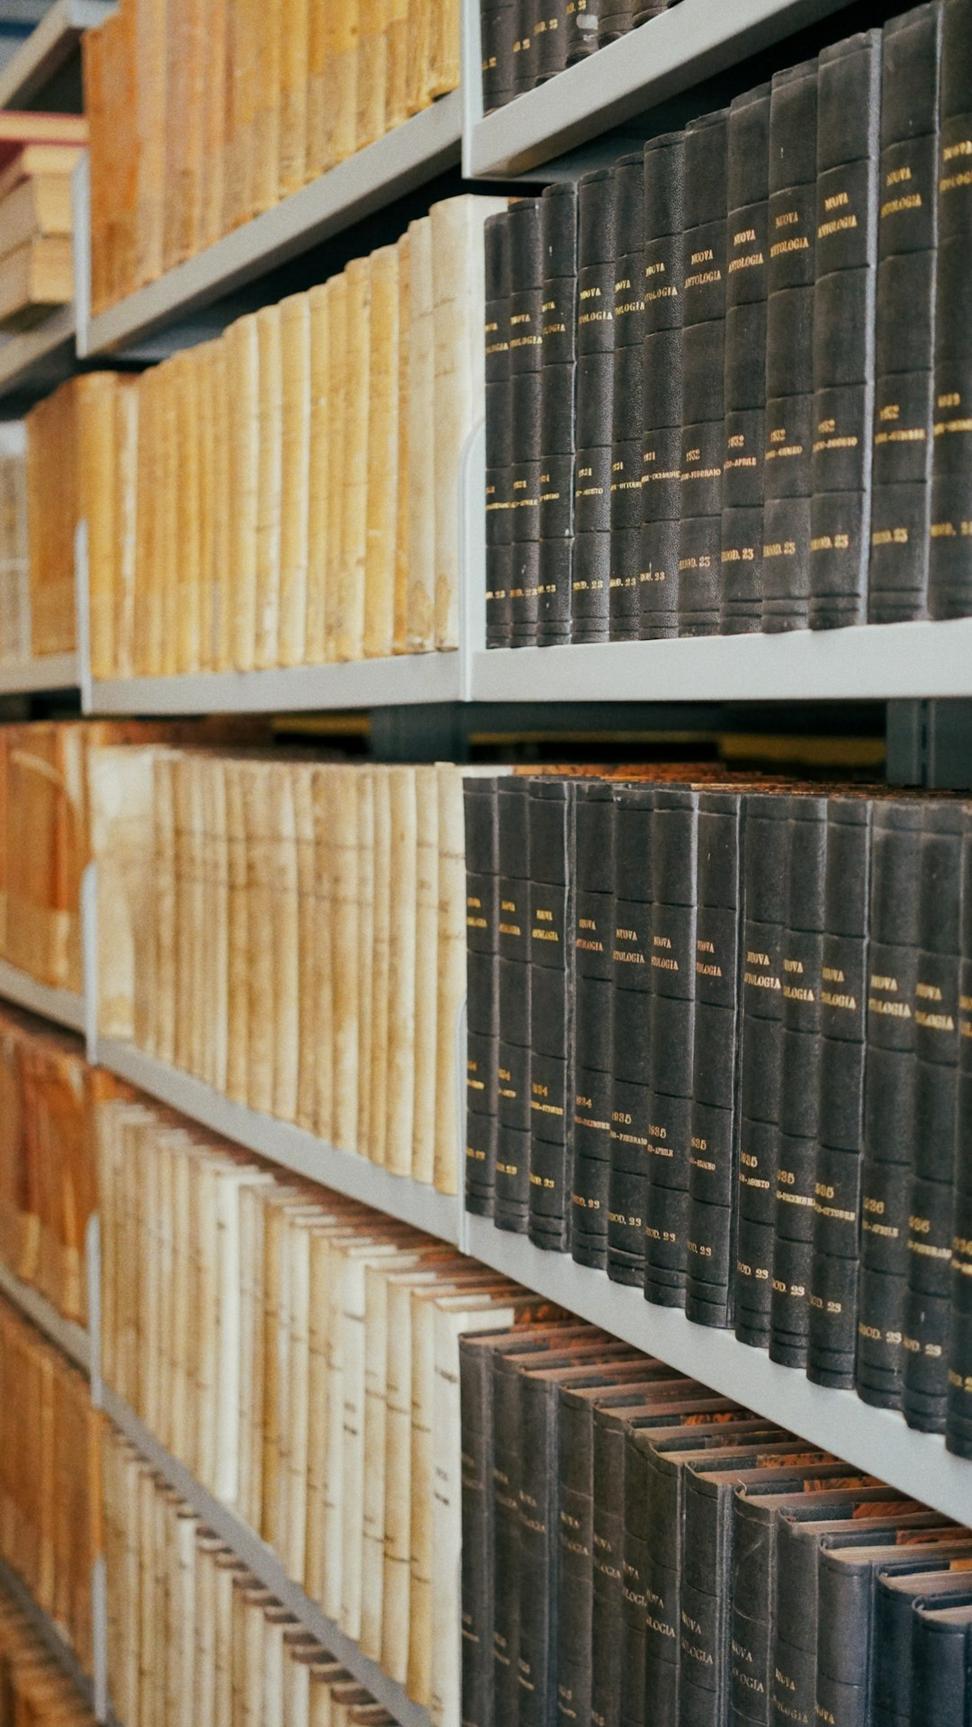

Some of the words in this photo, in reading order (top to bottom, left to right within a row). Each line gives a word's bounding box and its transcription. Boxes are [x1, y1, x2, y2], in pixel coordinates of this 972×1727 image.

[825, 192, 849, 212] NUOVA
[775, 211, 799, 230] NUOVA
[733, 228, 756, 247] NUOVA
[690, 249, 714, 265] NUOVA
[616, 928, 638, 941] NUOVA
